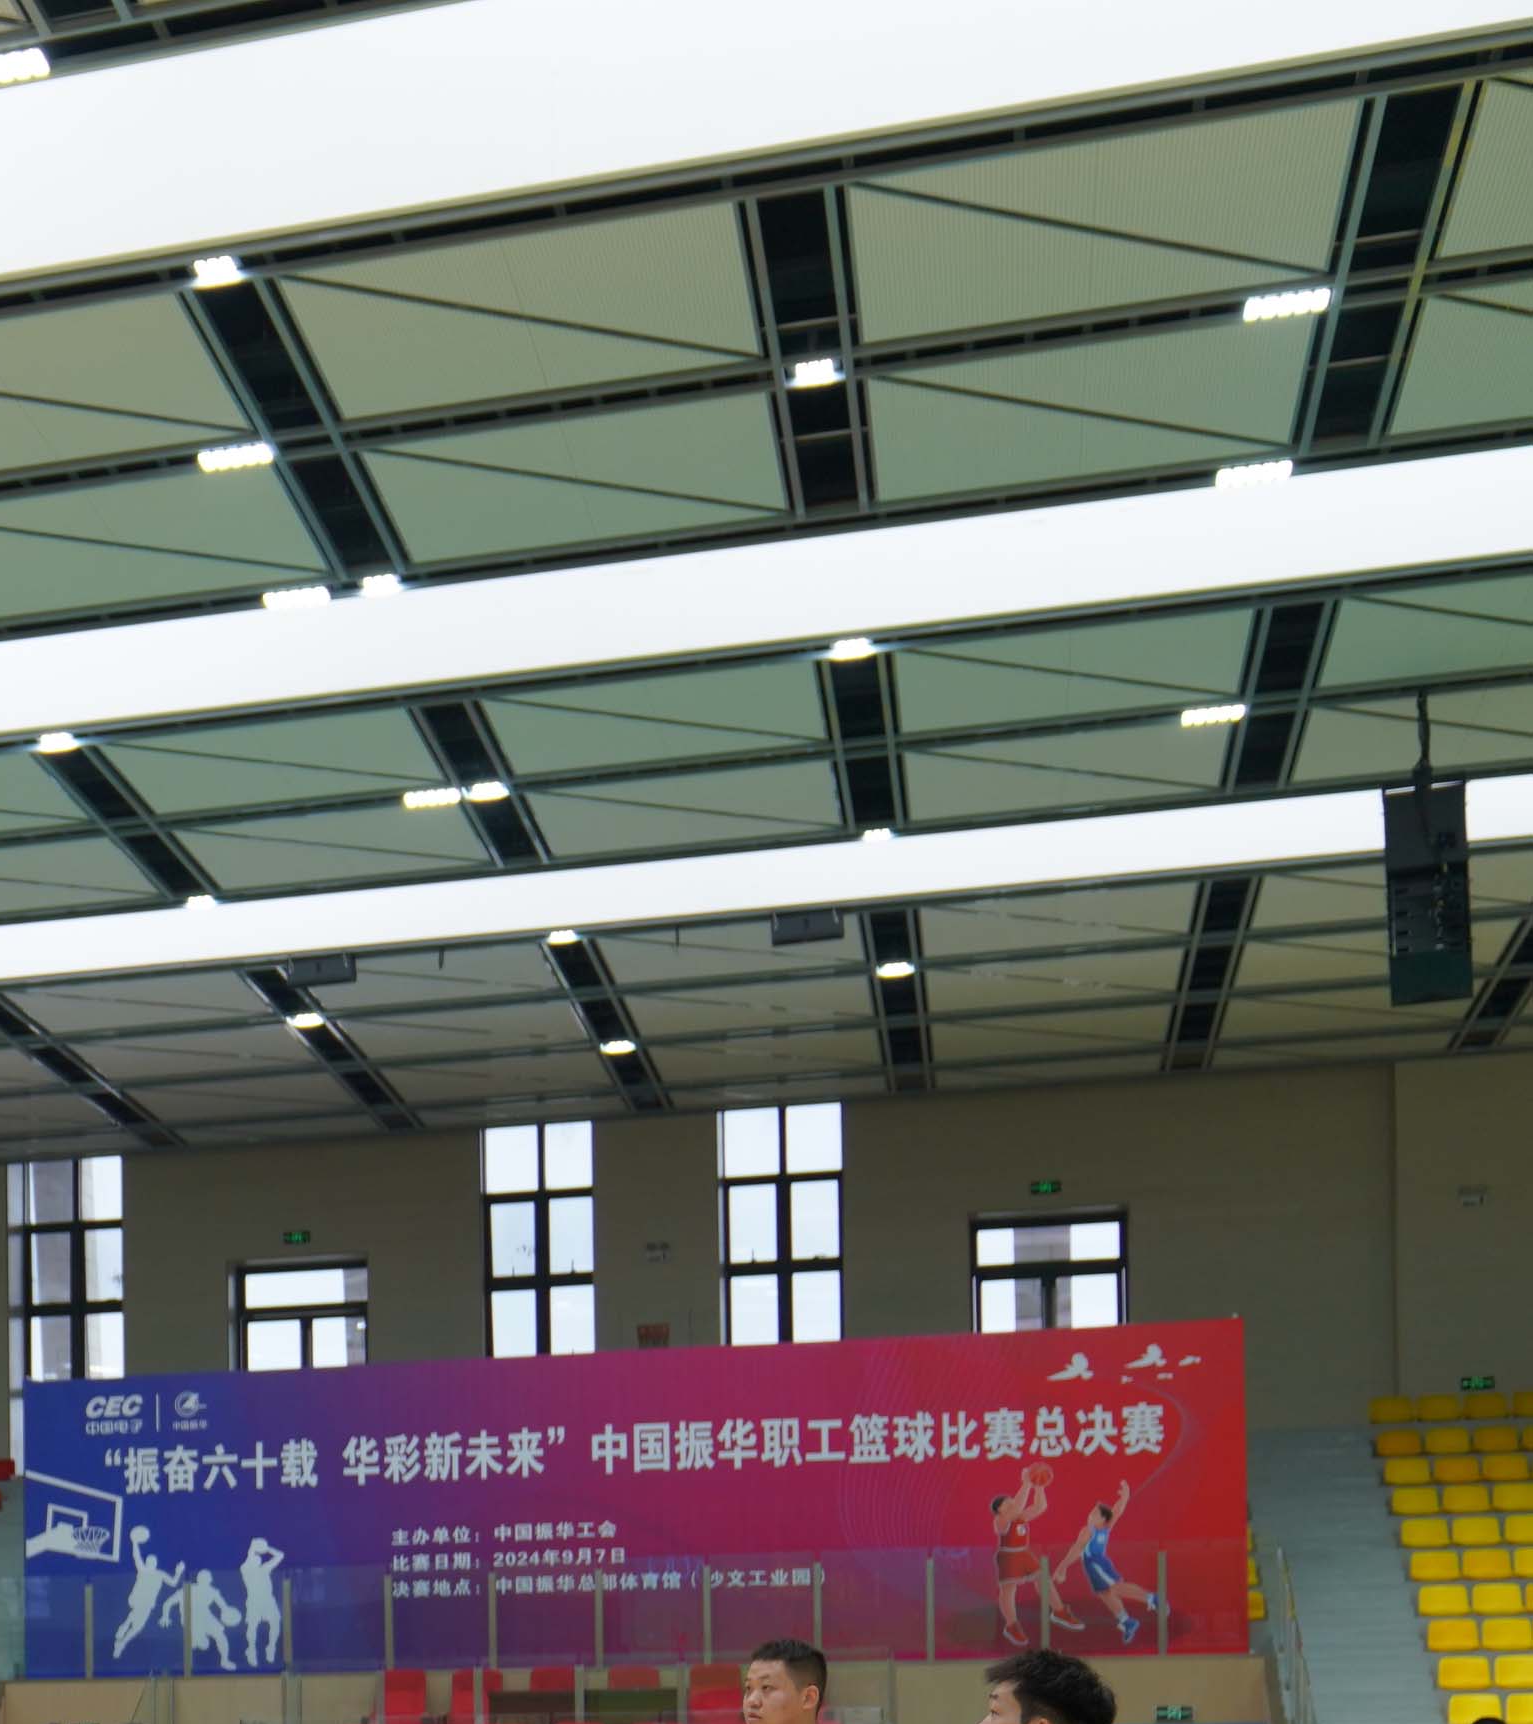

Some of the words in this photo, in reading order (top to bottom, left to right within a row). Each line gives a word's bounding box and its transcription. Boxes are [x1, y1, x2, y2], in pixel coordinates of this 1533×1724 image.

[85, 1394, 143, 1419] CEC
[590, 1402, 1166, 1475] 中国振华职工篮球比赛总决赛
[492, 1546, 627, 1568] 2024年9月7日
